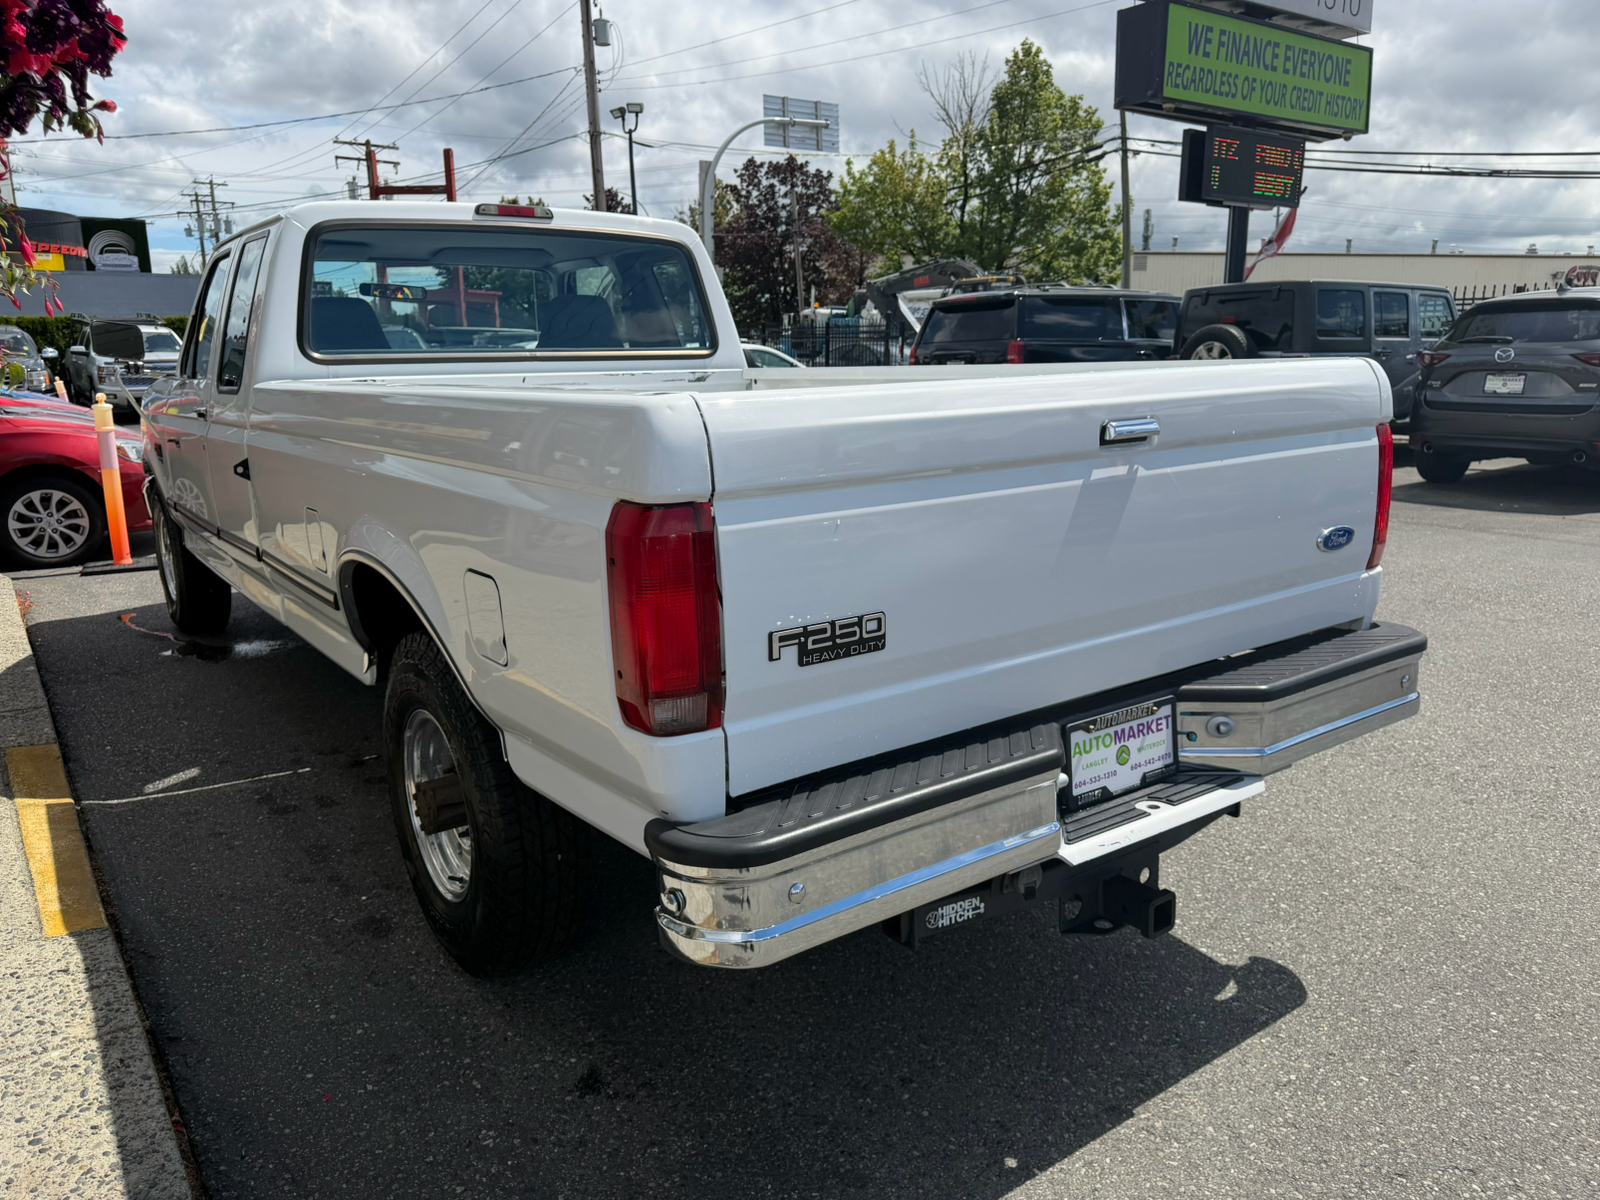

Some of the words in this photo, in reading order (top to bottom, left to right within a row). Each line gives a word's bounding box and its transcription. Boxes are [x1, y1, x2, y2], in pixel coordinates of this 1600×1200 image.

[1188, 21, 1215, 58] WE
[1216, 29, 1281, 73] FINANCE
[1282, 45, 1353, 88] EVERYONE
[1166, 61, 1239, 100] REGARDLESS
[1241, 76, 1257, 102] OF
[1259, 79, 1289, 110] YOUR
[1289, 85, 1325, 115] CREDIT
[1325, 93, 1365, 122] HISTORY
[803, 647, 846, 664] HEAVY
[850, 639, 885, 655] DUTY
[1094, 703, 1154, 731] AUTOMARKET
[1072, 714, 1171, 758] AUTOMARKET
[1081, 757, 1108, 771] LANGLEY
[1074, 770, 1117, 789] 604-533-1310
[938, 896, 980, 917] HIDDEN
[938, 908, 972, 928] HITCH
